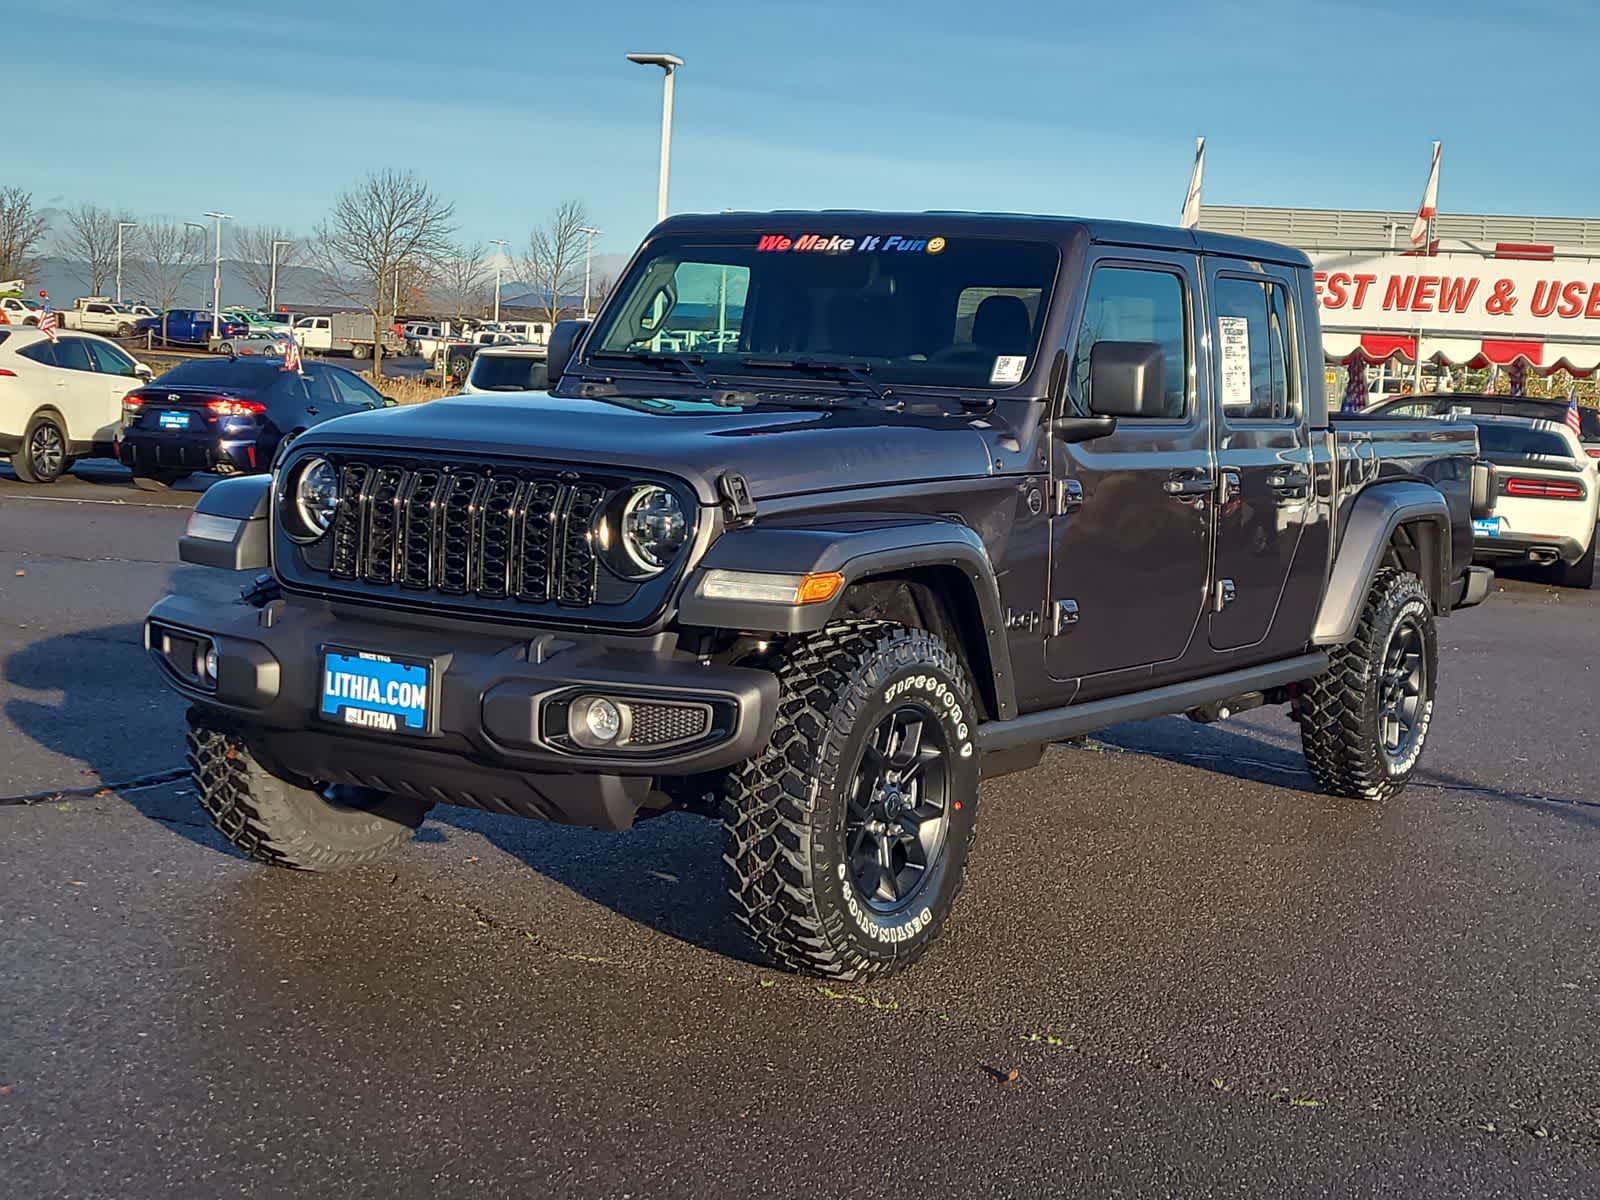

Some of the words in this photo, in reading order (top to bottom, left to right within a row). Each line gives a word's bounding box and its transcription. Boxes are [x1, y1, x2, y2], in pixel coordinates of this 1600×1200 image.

[757, 235, 791, 251] We
[794, 235, 855, 251] Make
[858, 236, 880, 251] It
[882, 236, 926, 251] Fun
[1383, 275, 1479, 313] NEW
[1485, 278, 1518, 315] &
[326, 671, 426, 710] LITHIA.COM
[358, 709, 397, 730] LITHIA
[842, 880, 933, 943] DESTINATION
